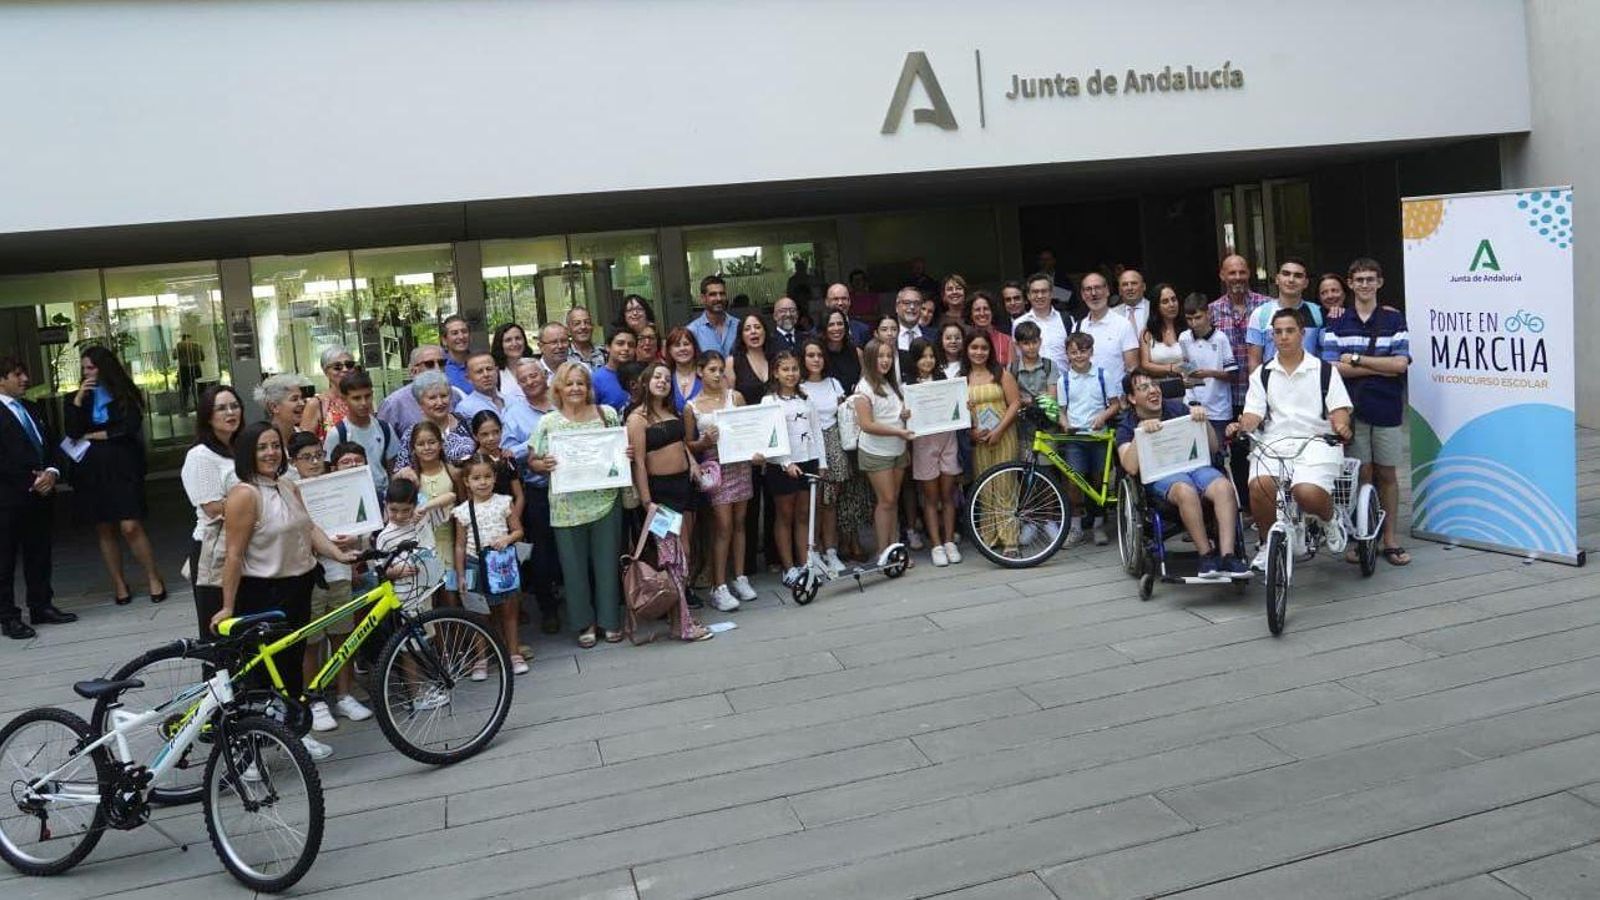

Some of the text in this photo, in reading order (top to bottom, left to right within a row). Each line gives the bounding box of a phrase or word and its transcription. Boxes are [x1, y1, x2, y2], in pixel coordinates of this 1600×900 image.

[1006, 61, 1244, 101] Junta de Andalucía
[1450, 272, 1522, 283] Junta de Andalucía
[1430, 309, 1498, 333] PONTE EN
[1431, 335, 1548, 373] MARCHA
[1445, 375, 1500, 387] CONCURSO
[1501, 378, 1548, 389] ESCOLAR
